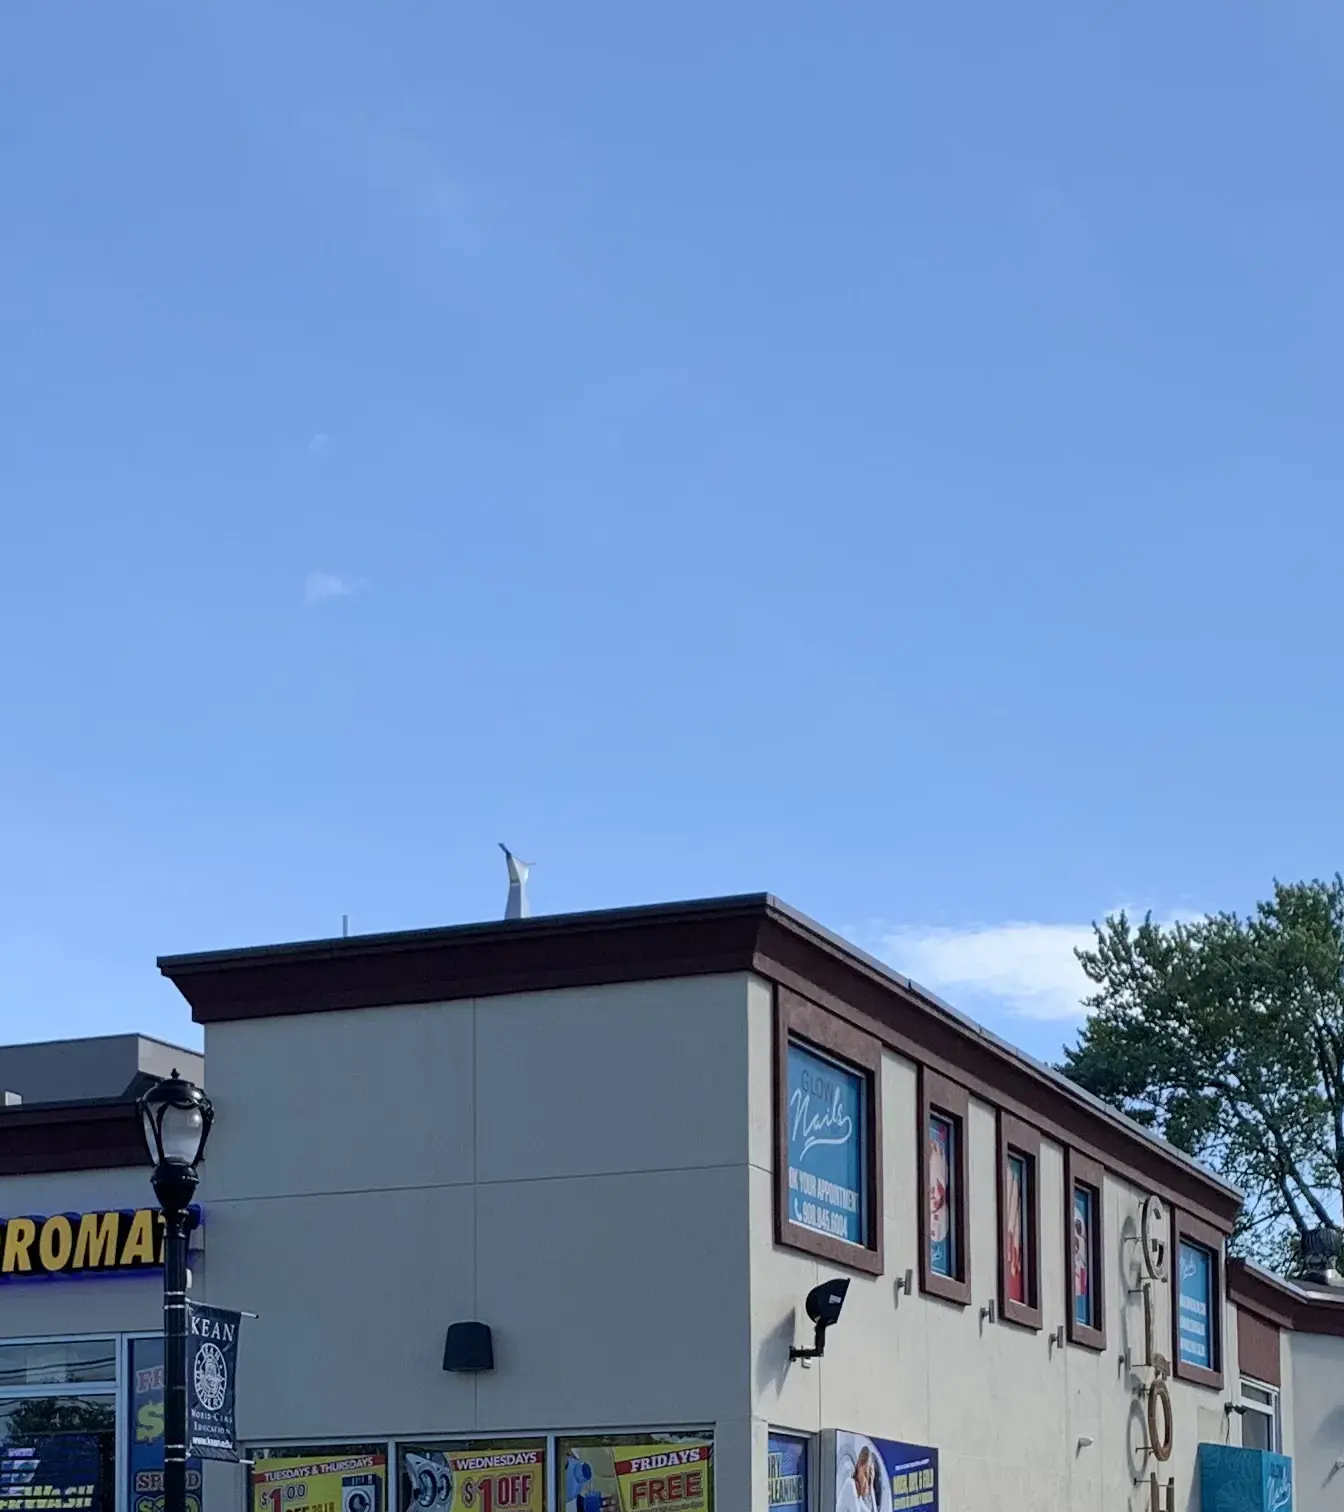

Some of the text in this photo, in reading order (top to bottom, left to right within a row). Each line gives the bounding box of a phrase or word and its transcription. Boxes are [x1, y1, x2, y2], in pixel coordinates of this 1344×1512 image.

[790, 1087, 853, 1160] Nails
[799, 1170, 816, 1197] YOUR
[191, 1316, 235, 1342] KEAN
[264, 1456, 373, 1482] TUESDAYS & THURSDAYS
[456, 1451, 537, 1470] WEDNESDAYS
[631, 1448, 701, 1473] FRIDAYS
[137, 1472, 201, 1491] SPD
[497, 1474, 532, 1506] OFF
[631, 1472, 702, 1507] FREE
